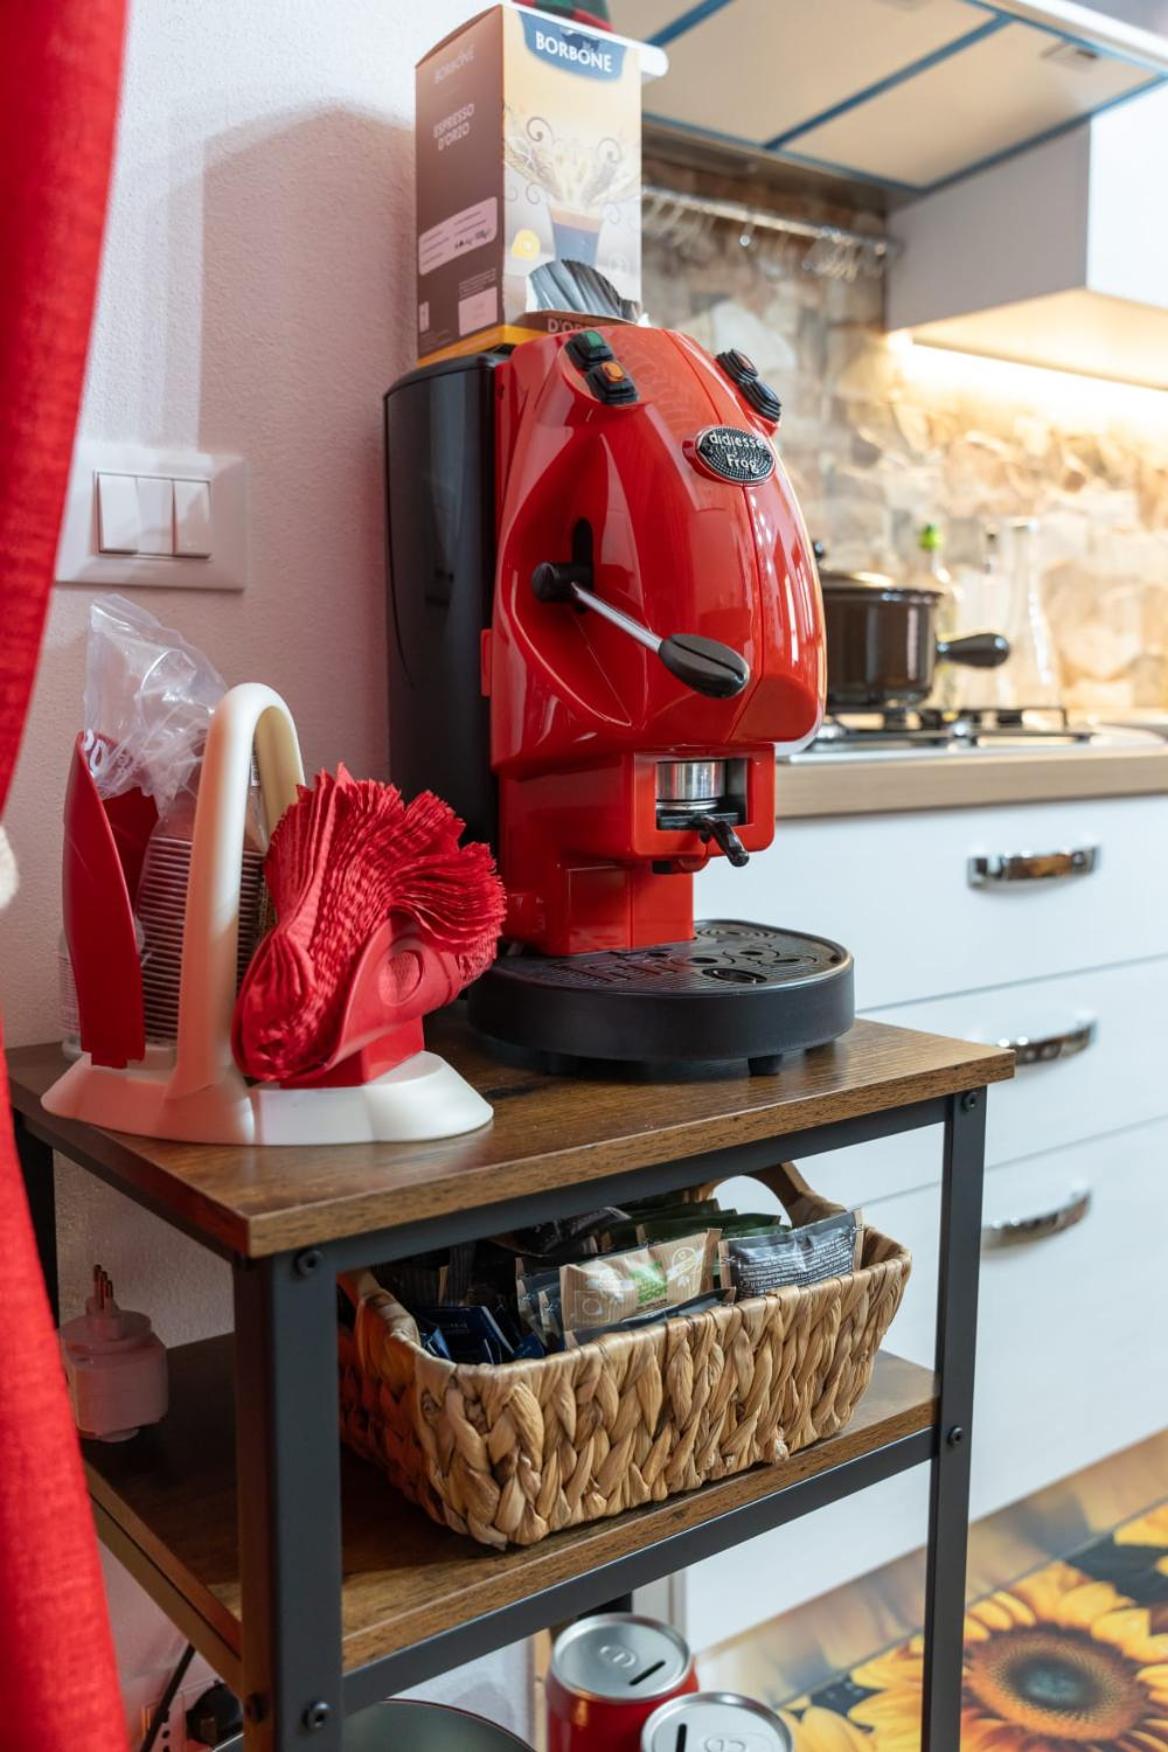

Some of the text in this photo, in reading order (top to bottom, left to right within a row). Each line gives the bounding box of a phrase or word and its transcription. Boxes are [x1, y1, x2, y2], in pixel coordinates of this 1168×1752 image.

[535, 30, 612, 72] BORBONE
[708, 431, 764, 449] didiesse
[726, 453, 760, 474] Frog
